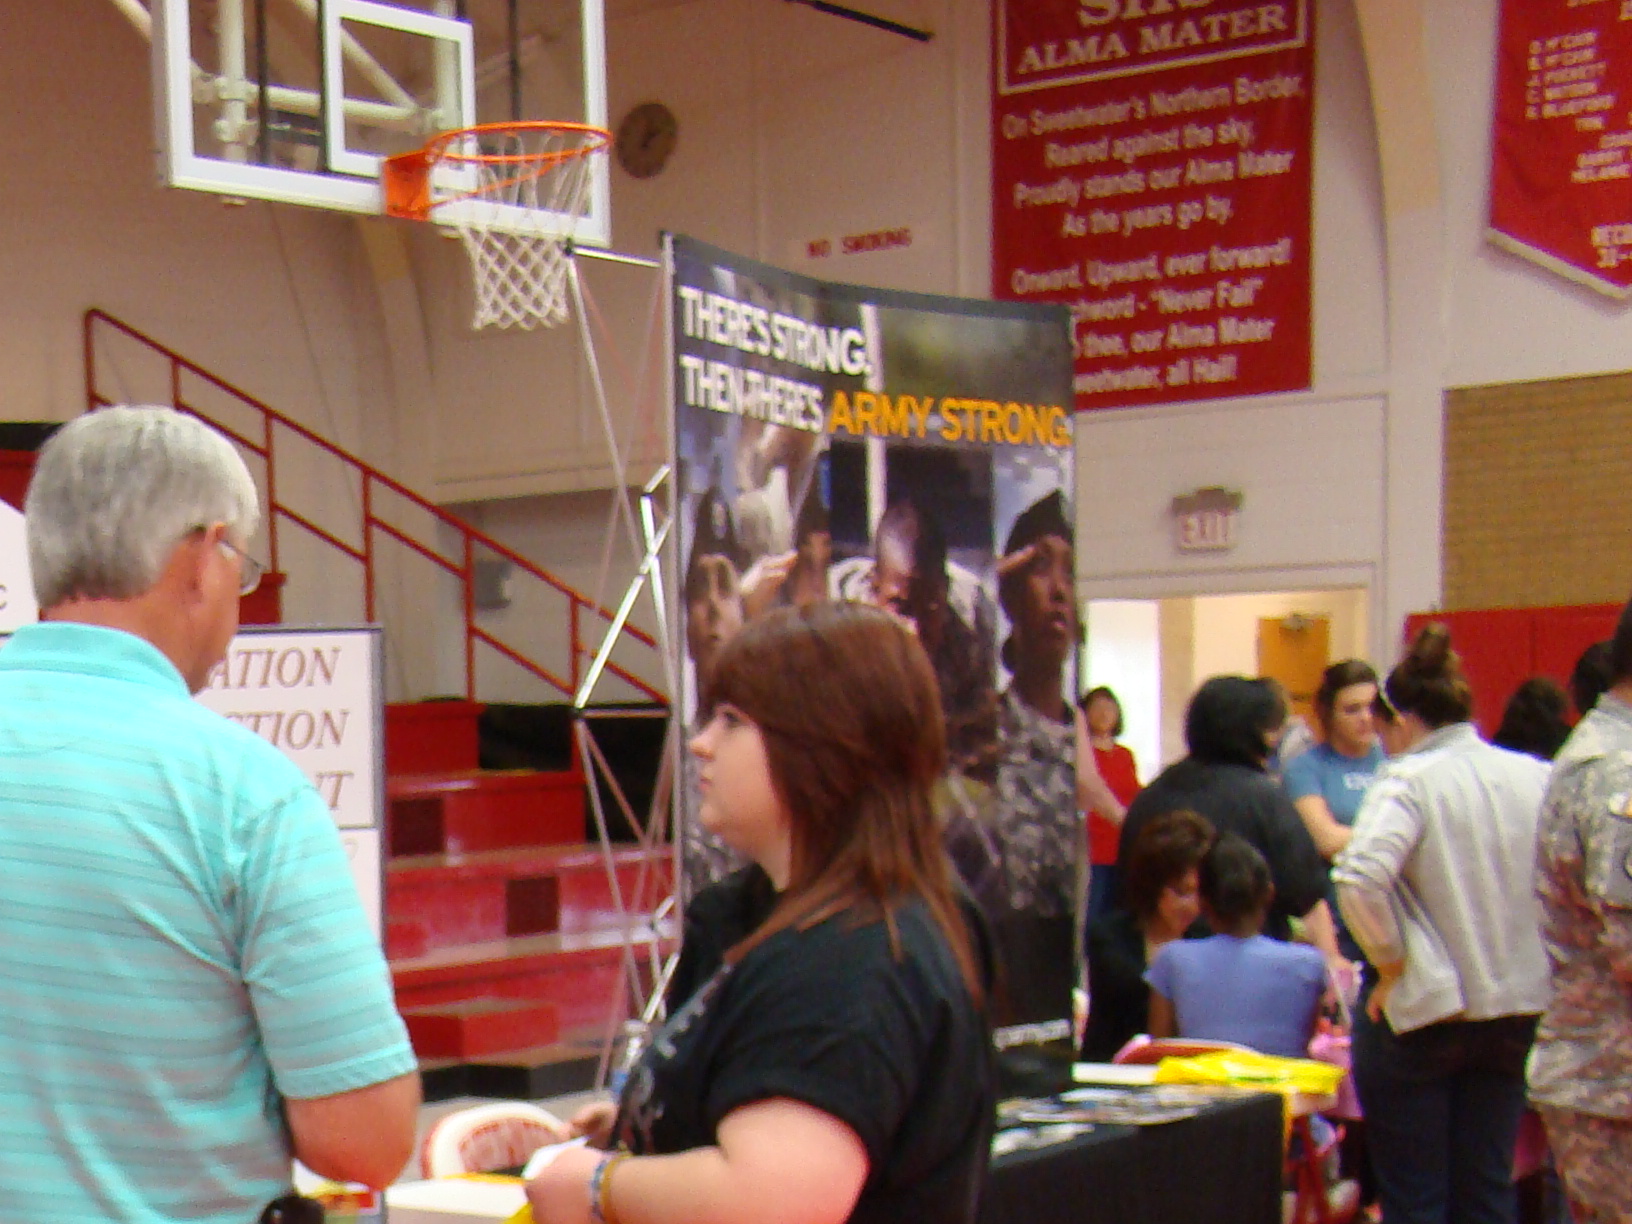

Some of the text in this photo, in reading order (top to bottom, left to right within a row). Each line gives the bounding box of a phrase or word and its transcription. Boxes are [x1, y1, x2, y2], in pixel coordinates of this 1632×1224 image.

[1018, 33, 1130, 75] ALMA
[1140, 4, 1288, 54] MATER
[1182, 122, 1214, 149] the
[1083, 170, 1146, 200] stands
[1148, 167, 1181, 191] our
[1184, 158, 1235, 187] Alma
[1237, 150, 1294, 179] Mater
[1088, 209, 1119, 234] the
[1123, 205, 1173, 236] years
[1177, 201, 1203, 230] go
[842, 227, 912, 254] SMOKING
[1166, 321, 1216, 349] Alma
[1218, 316, 1276, 344] Mater
[828, 389, 935, 438] ARMY
[205, 646, 342, 690] ATION
